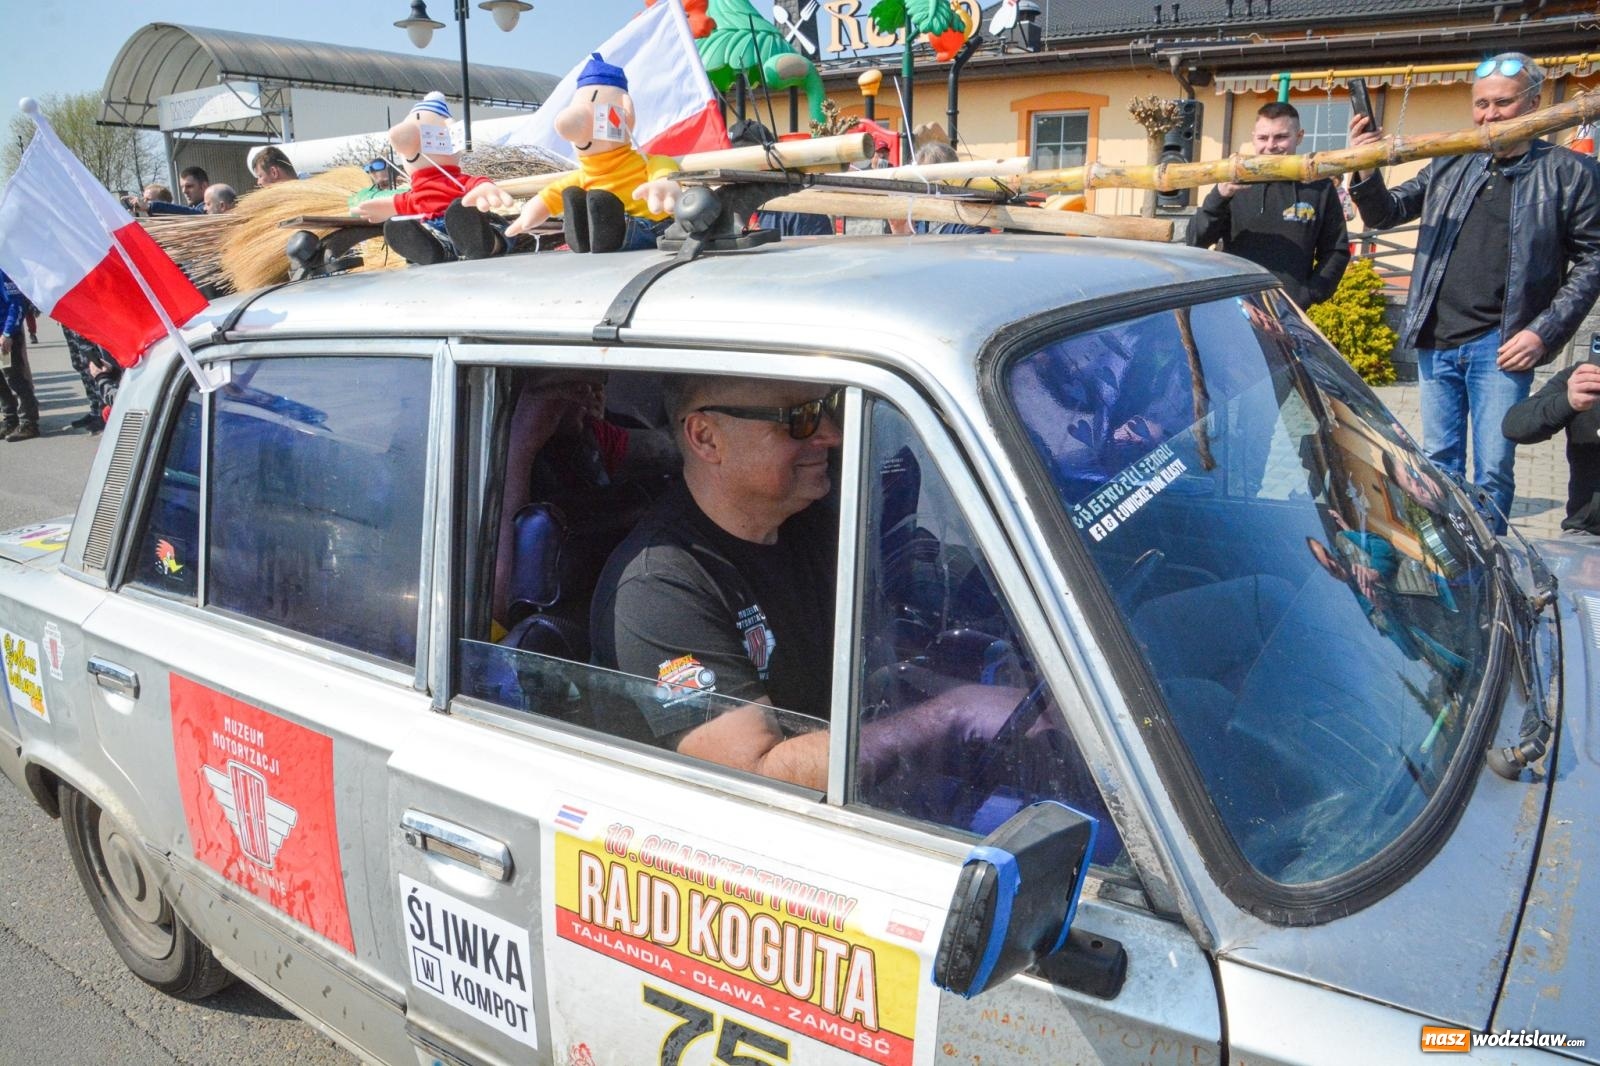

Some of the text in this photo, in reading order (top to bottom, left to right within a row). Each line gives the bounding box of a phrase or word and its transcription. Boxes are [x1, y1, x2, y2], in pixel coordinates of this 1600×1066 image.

[212, 731, 280, 775] MOTORYZACJI
[224, 716, 264, 747] MUZEUM
[639, 835, 858, 932] CHARYTATYWNY
[407, 887, 526, 993] ŚLIWKA
[571, 921, 673, 973] TAJLANDIA
[692, 970, 766, 1009] OŁAWA
[788, 1005, 890, 1056] ZAMOŚĆ
[578, 850, 880, 1032] RAJD KOGUTA
[421, 957, 529, 1033] W KOMPOT
